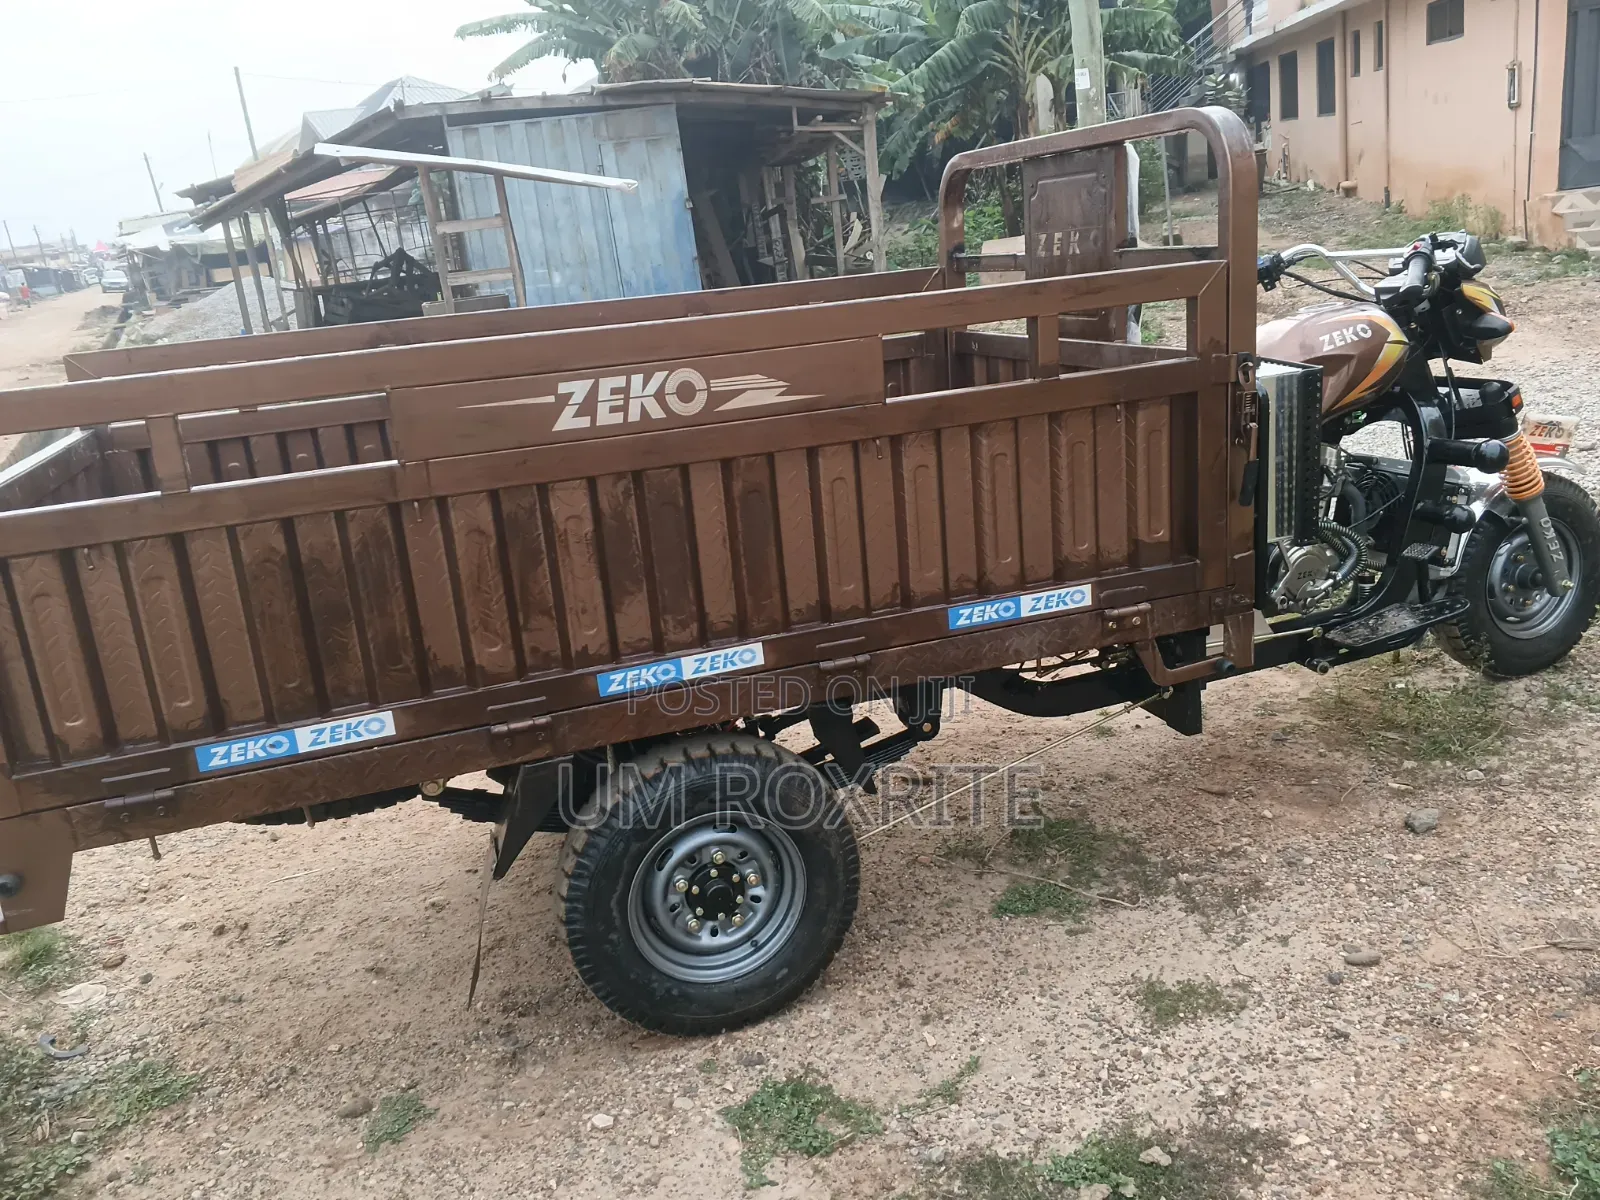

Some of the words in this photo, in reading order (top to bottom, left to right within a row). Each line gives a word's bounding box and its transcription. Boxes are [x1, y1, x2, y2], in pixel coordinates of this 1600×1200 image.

[1319, 323, 1372, 352] ZEKO
[551, 367, 708, 432] ZEKO
[1528, 424, 1565, 439] ZEKO
[1540, 517, 1565, 562] ZEKO
[956, 600, 1016, 626] ZEKO
[1027, 588, 1086, 613] ZEKO
[607, 663, 676, 693] ZEKO
[691, 647, 757, 675] ZEKO
[208, 735, 290, 767] ZEKO
[307, 716, 387, 748] ZEKO
